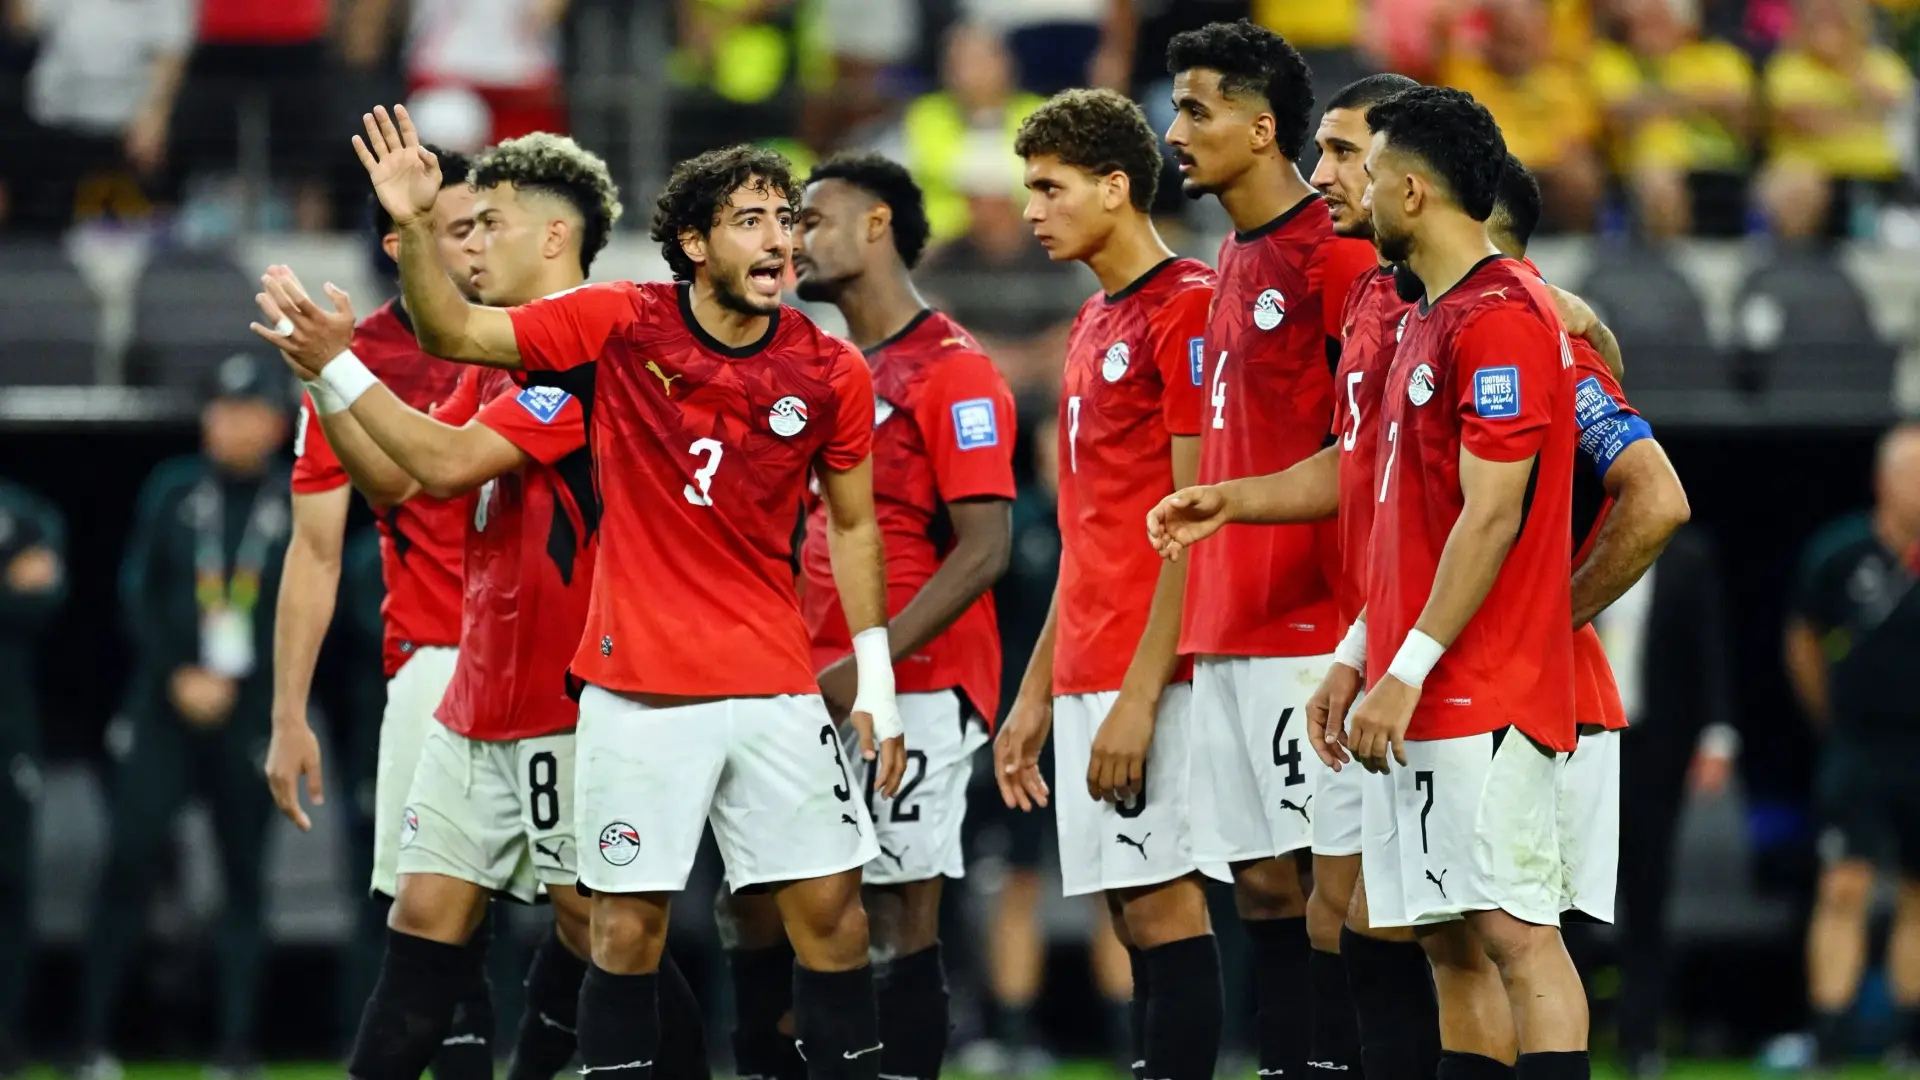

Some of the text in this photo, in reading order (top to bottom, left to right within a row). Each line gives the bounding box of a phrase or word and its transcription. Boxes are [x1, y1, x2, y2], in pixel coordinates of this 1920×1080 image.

[1211, 351, 1228, 429] 4
[1344, 372, 1364, 451] 5
[1481, 374, 1511, 384] FOOTBALL
[1481, 383, 1512, 395] UNITES
[1575, 391, 1602, 412] UNITES
[1589, 397, 1608, 414] World
[684, 437, 723, 506] 3
[1379, 421, 1398, 502] 7
[1601, 421, 1630, 449] World
[819, 724, 850, 802] 3
[1272, 707, 1305, 787] 4
[529, 751, 560, 831] 8
[863, 749, 928, 824] 12
[1415, 771, 1434, 854] 7
